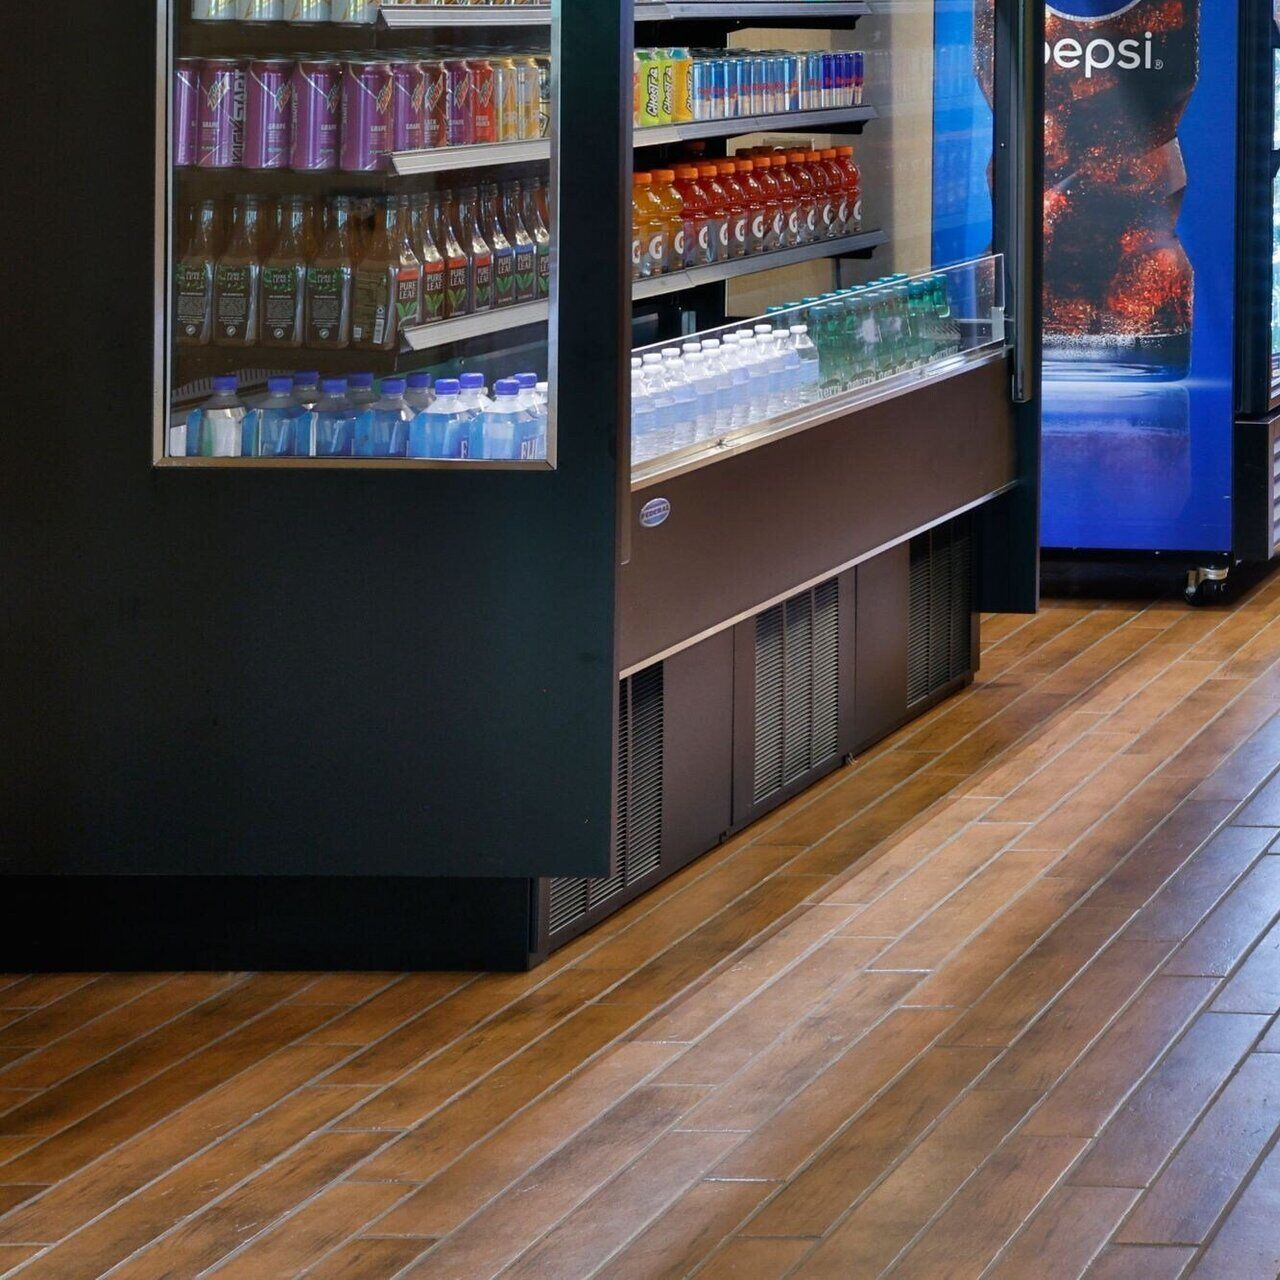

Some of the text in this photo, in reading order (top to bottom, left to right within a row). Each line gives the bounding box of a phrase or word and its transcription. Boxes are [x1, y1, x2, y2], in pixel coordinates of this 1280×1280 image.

[753, 216, 763, 238] G
[649, 235, 662, 259] G
[518, 253, 532, 262] PURE
[518, 261, 532, 271] LEAF
[427, 273, 443, 282] PURE
[450, 268, 466, 277] PURE
[400, 281, 416, 290] PURE
[427, 281, 442, 291] LEAF
[450, 276, 466, 287] LEAF
[400, 290, 416, 300] LEAF
